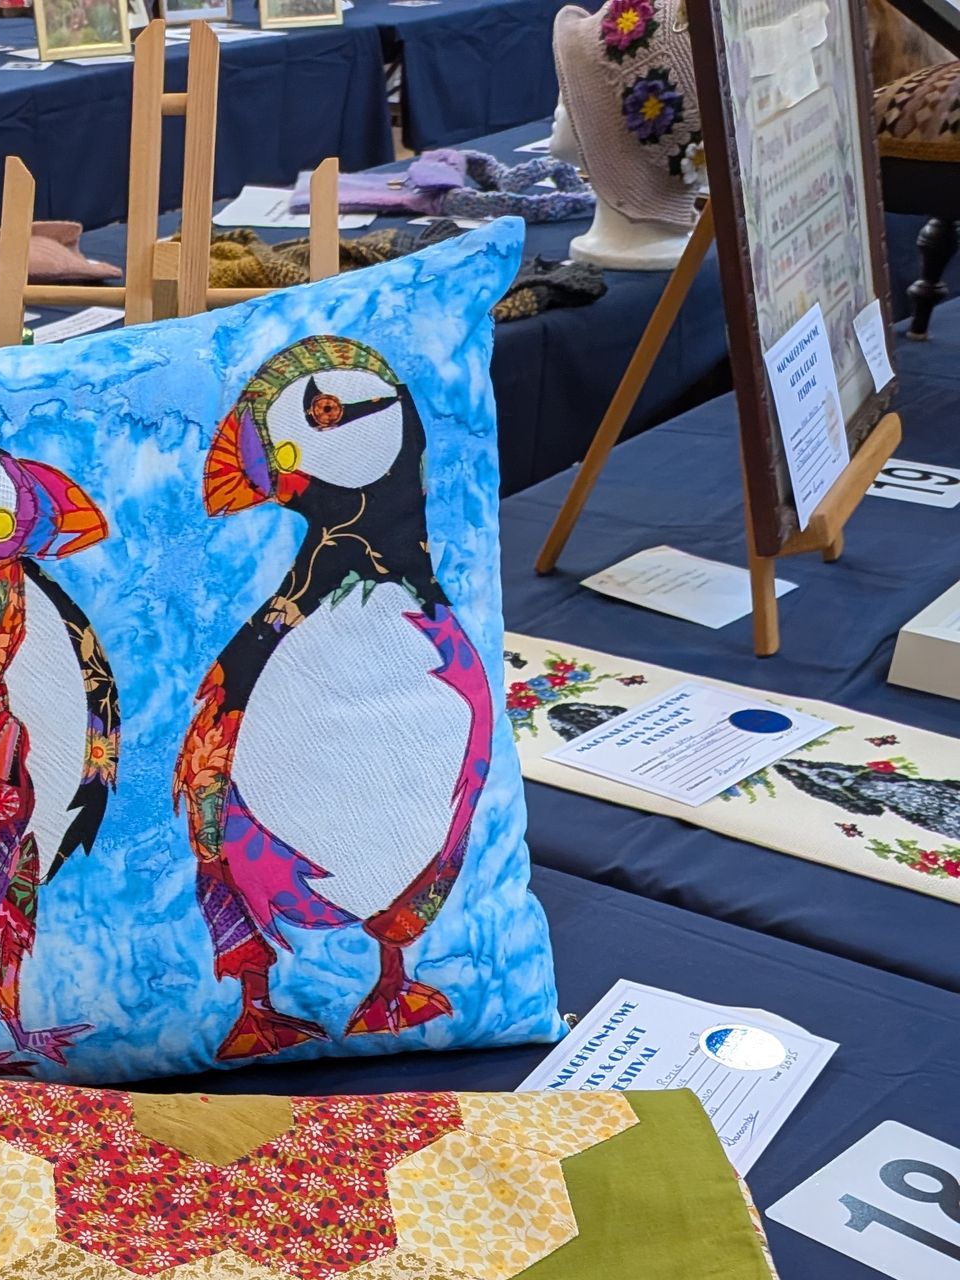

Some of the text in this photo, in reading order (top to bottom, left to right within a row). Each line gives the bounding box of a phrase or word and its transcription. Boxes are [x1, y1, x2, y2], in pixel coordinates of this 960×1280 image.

[873, 467, 960, 495] 19
[598, 1063, 616, 1073] &
[607, 1026, 647, 1062] CRAFT
